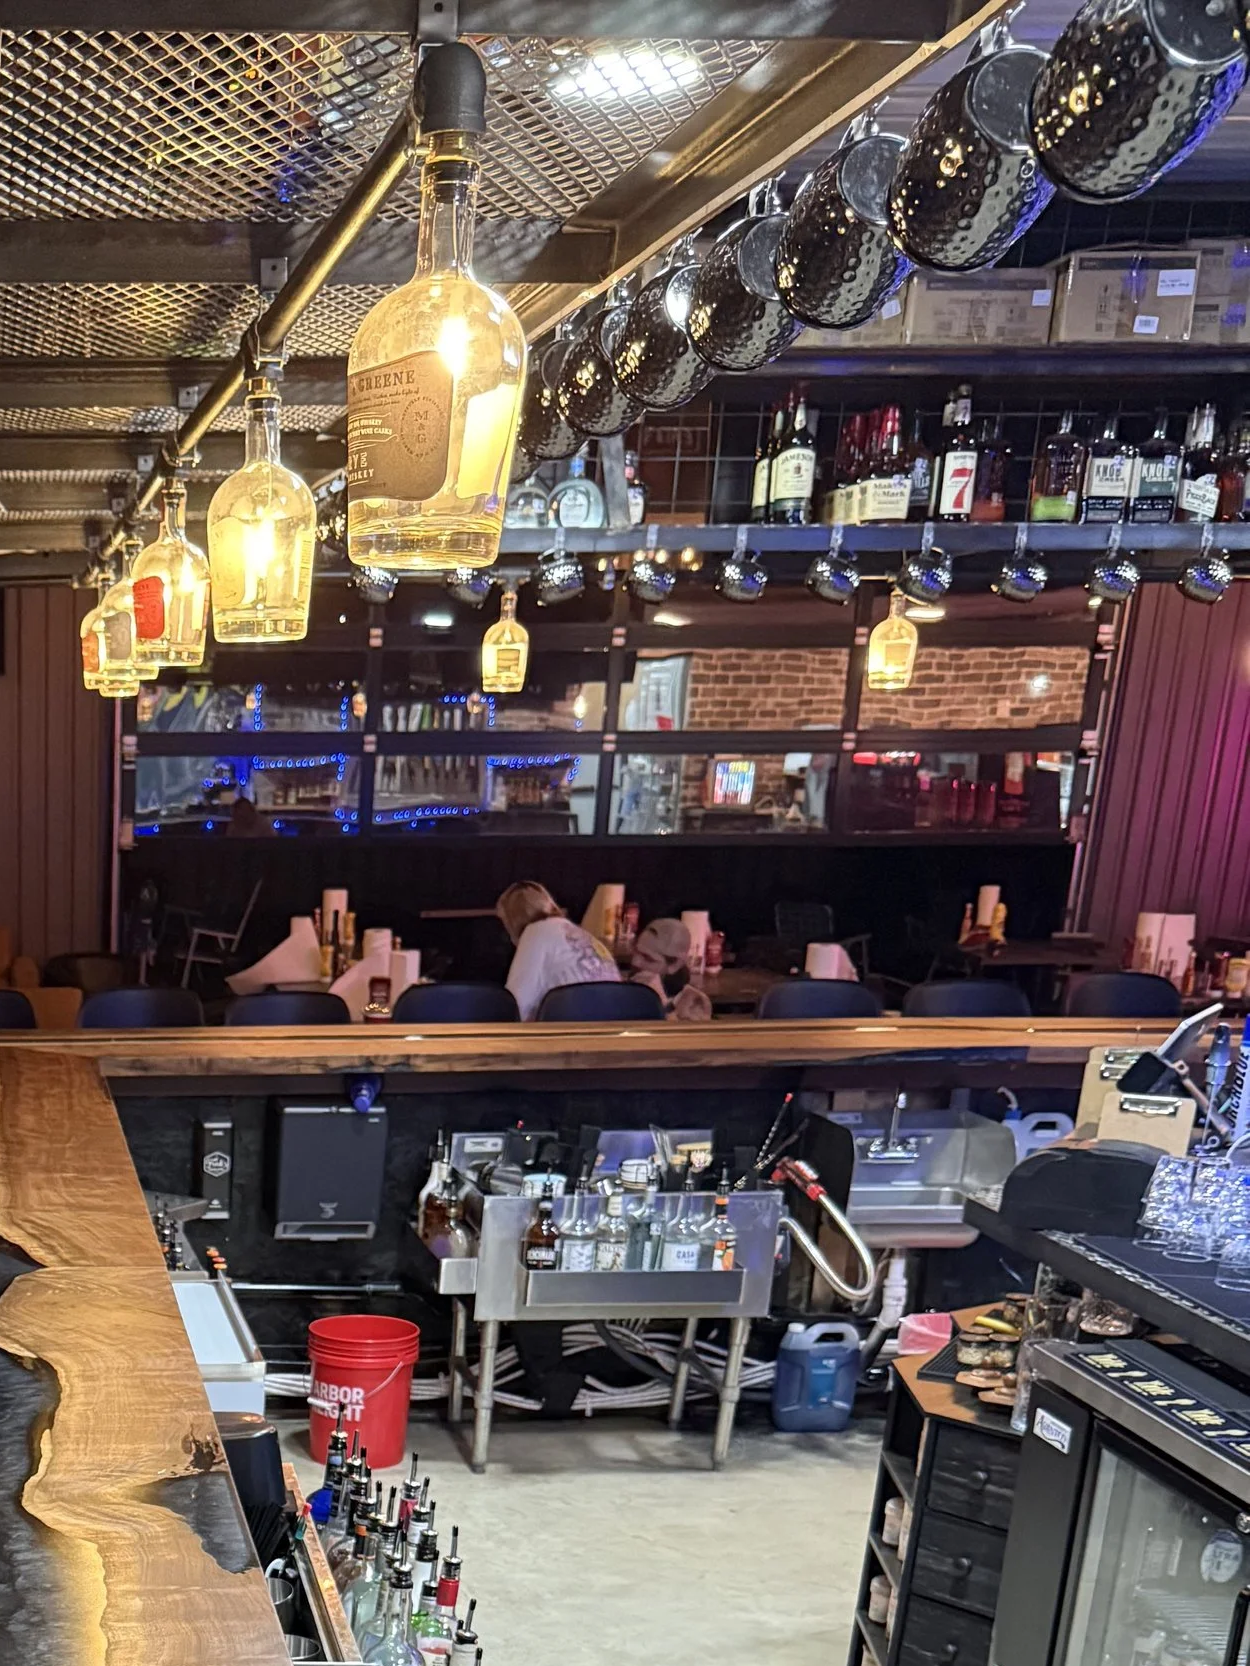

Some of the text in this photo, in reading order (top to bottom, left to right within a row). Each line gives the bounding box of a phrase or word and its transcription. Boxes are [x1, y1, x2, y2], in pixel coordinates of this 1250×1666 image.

[358, 369, 415, 392] GREENE
[1095, 464, 1122, 477] KNOB
[1142, 464, 1169, 477] KNOB
[950, 468, 973, 509] 7
[676, 1250, 695, 1259] CASA
